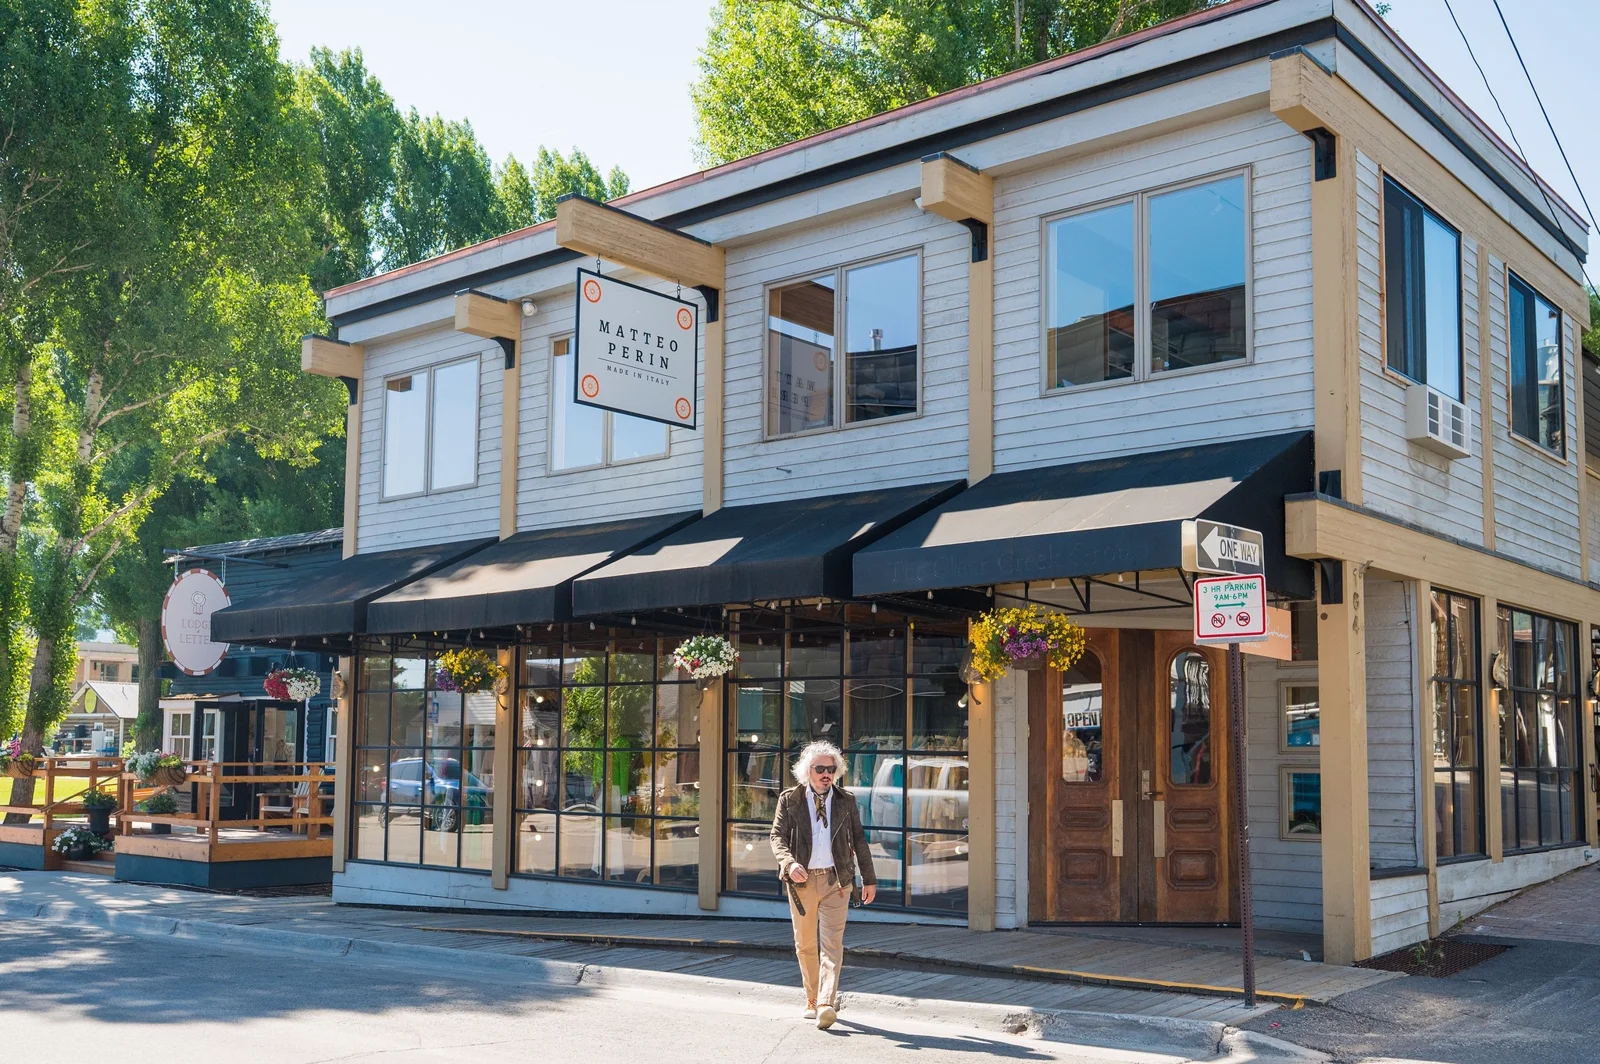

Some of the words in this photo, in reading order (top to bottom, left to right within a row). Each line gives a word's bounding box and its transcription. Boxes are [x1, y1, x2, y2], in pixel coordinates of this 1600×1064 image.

[599, 319, 678, 353] MATTEO
[608, 342, 669, 370] PERIN
[606, 365, 629, 376] MADE
[633, 371, 642, 379] IN
[646, 375, 670, 386] ITALY
[1220, 539, 1238, 559] ONE
[1240, 543, 1257, 563] WAY
[1203, 586, 1208, 594] 3
[1224, 582, 1257, 592] PARKING
[1213, 592, 1248, 601] 9AM-6PM
[180, 633, 216, 645] LETTE
[1067, 711, 1098, 727] OPEN
